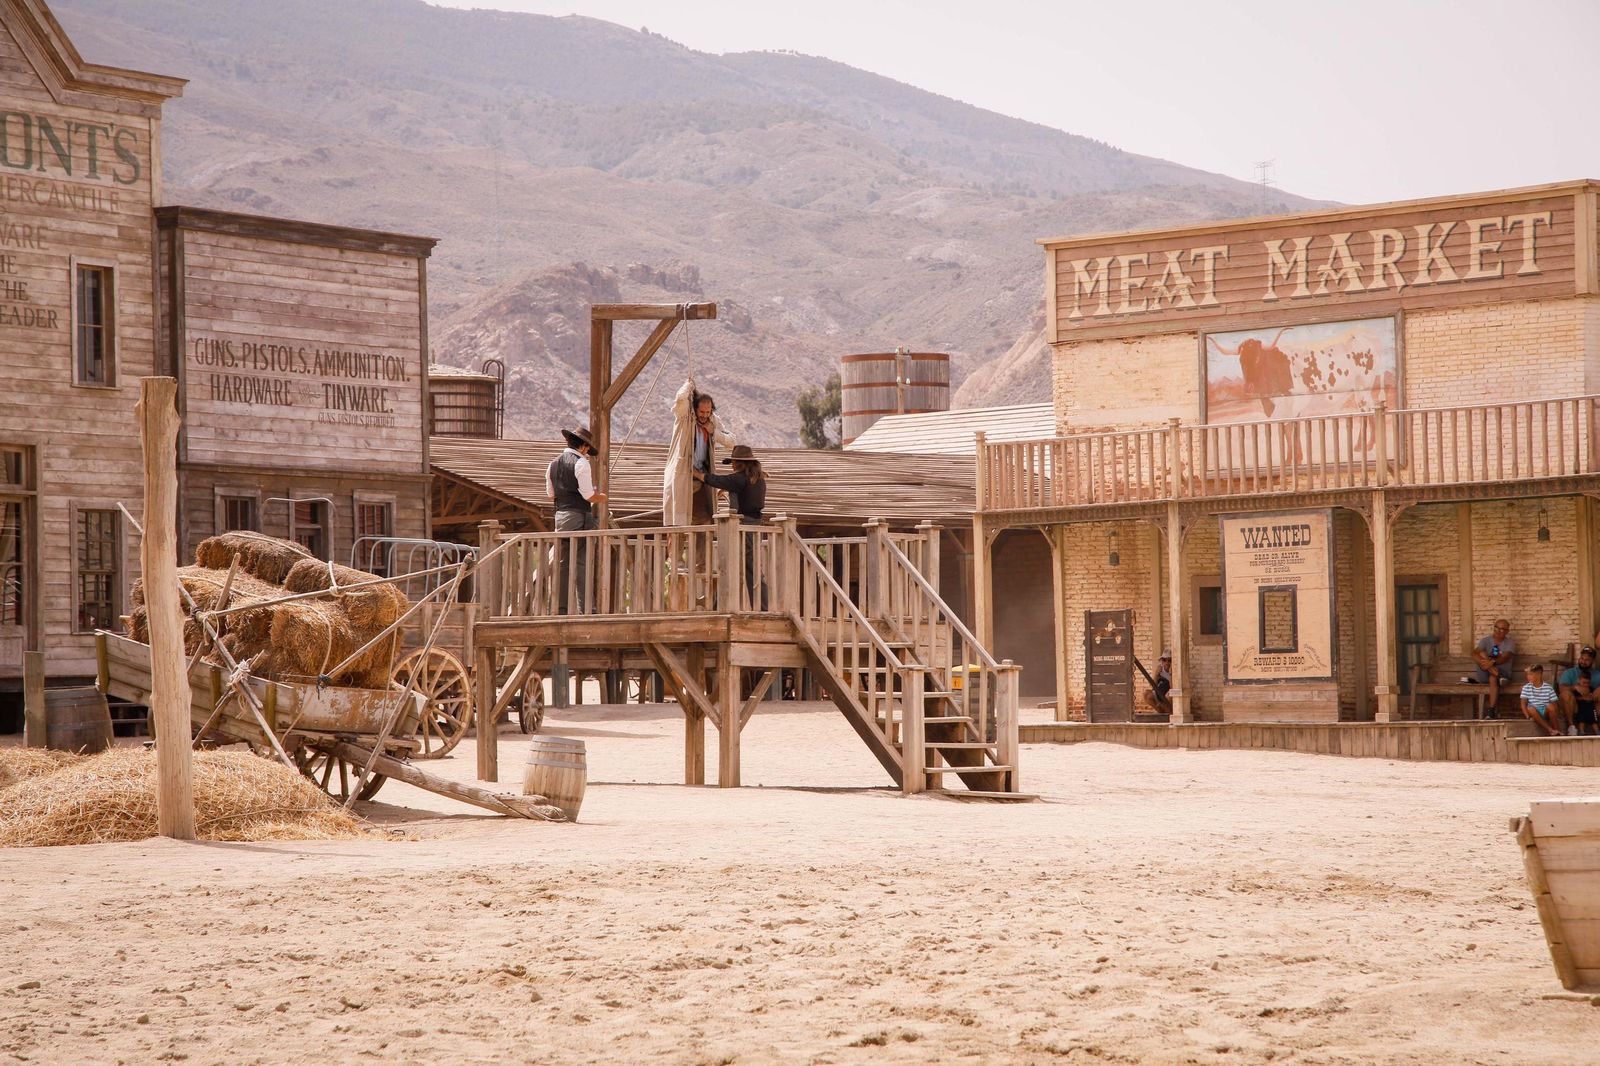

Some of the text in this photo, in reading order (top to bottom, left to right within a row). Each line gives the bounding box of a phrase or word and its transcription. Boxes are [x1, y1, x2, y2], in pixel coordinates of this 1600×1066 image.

[1068, 211, 1552, 320] MEAT MARKET
[210, 373, 293, 407] HARDWARE
[1240, 524, 1312, 549] WANTED
